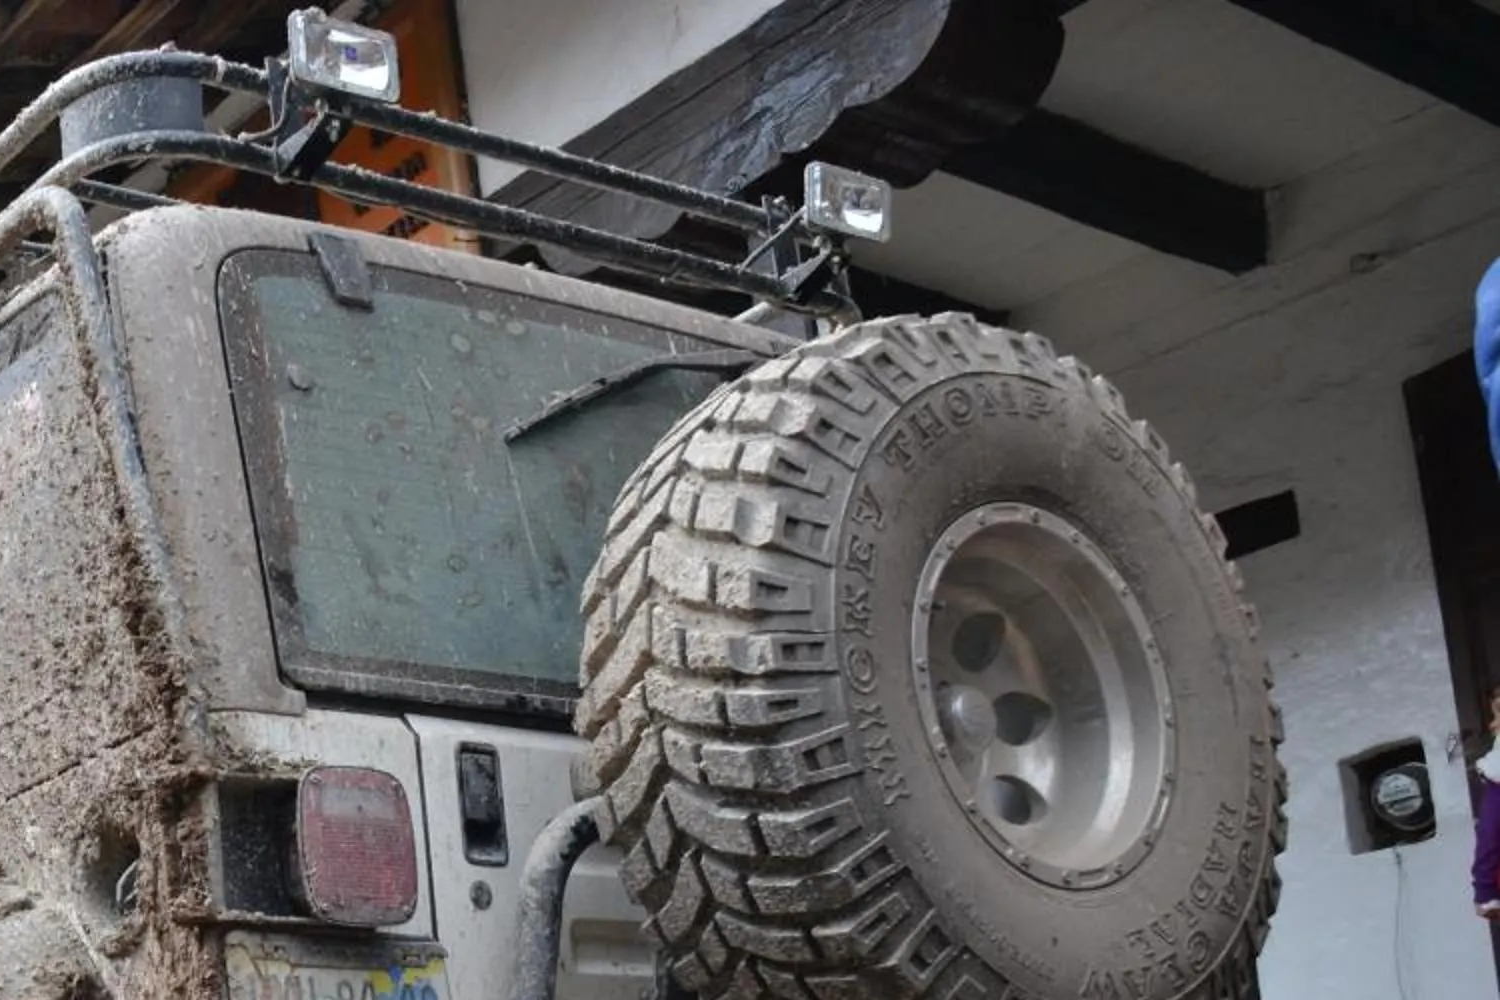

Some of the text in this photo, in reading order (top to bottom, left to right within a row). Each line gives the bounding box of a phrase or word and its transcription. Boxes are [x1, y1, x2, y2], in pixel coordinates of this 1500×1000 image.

[842, 380, 1160, 806] MICKEY THOMPON
[1124, 801, 1238, 960] RADIAL
